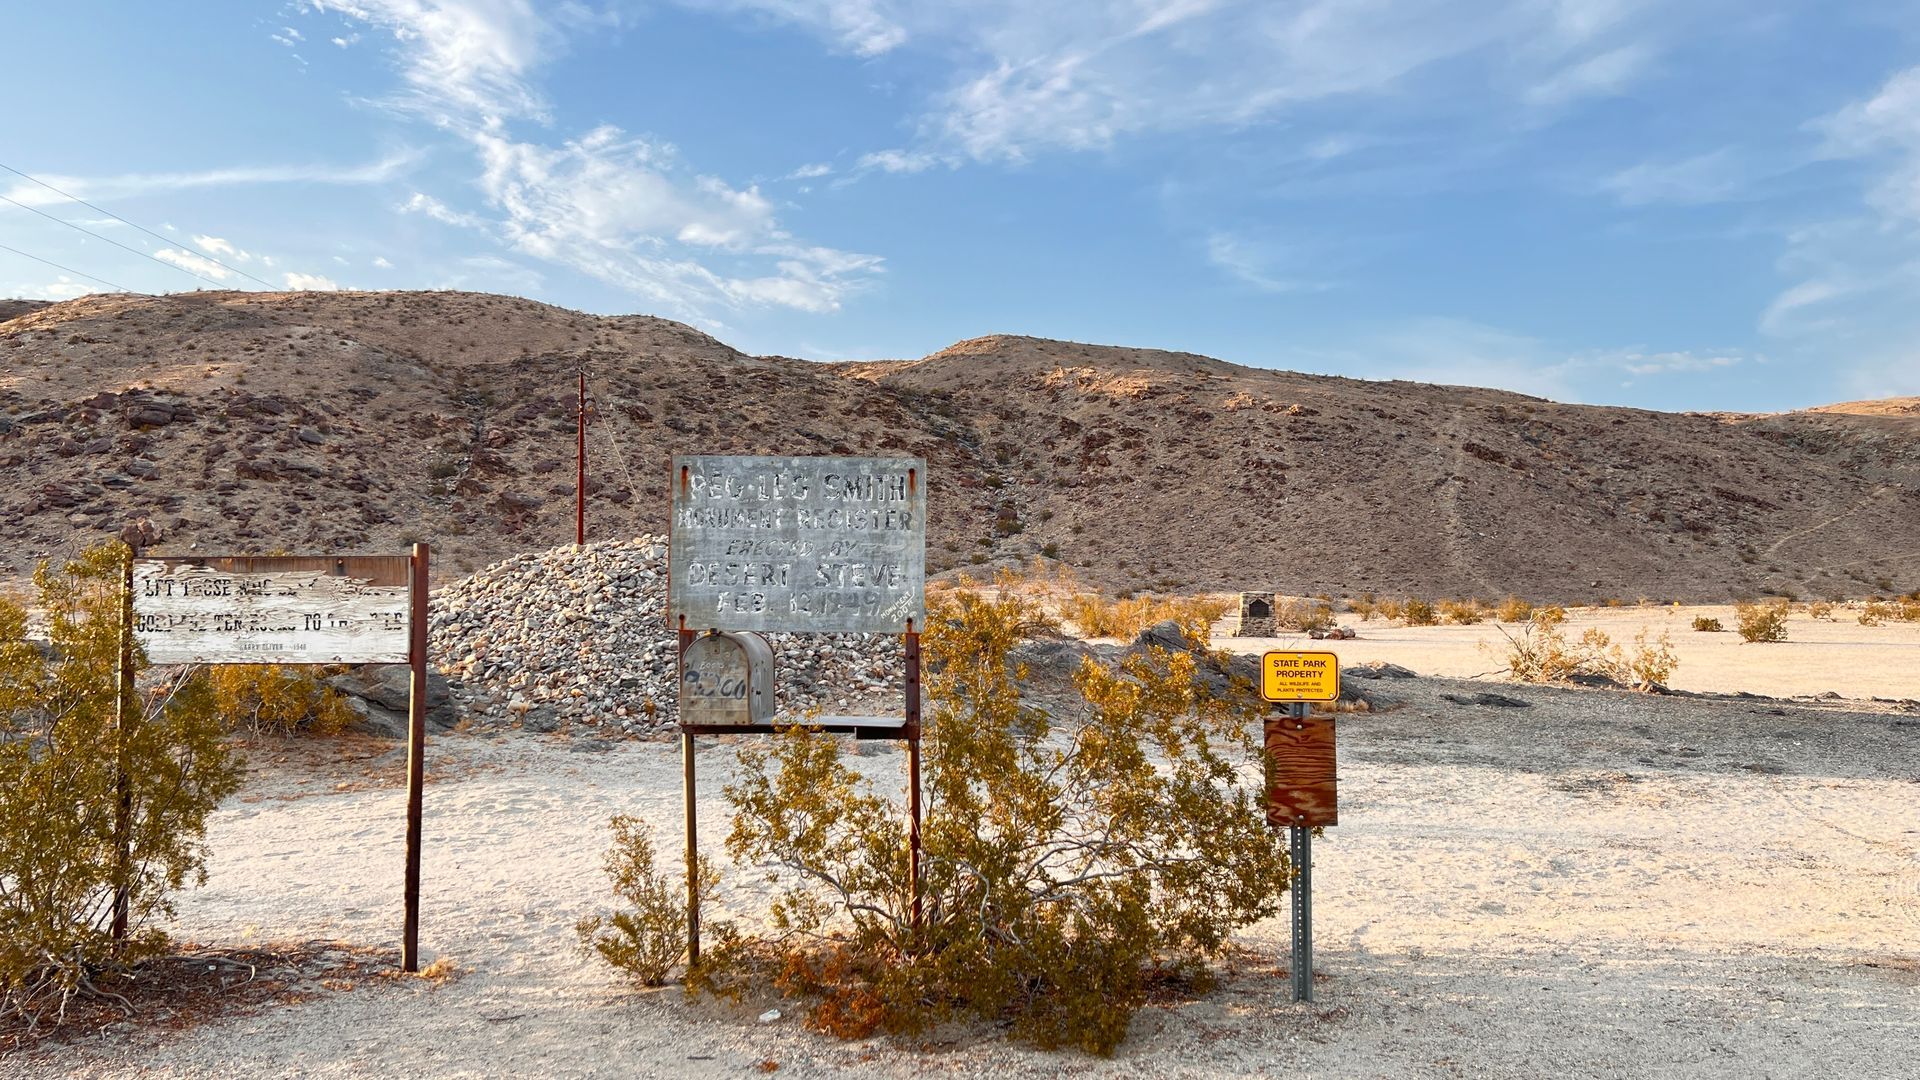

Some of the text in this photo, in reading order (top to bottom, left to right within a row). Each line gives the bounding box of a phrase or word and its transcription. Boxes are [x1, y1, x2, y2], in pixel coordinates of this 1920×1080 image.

[823, 473, 906, 502] SMITH
[677, 508, 913, 531] MONUMENT REGISTER
[725, 538, 862, 557] ERECTED BY
[688, 560, 903, 589] DESERT STEVE
[181, 579, 231, 596] TOSE
[880, 591, 911, 620] MONUMENT
[304, 613, 322, 631] TO
[1273, 660, 1327, 668] STATE PARK
[1276, 670, 1324, 678] PROPERTY
